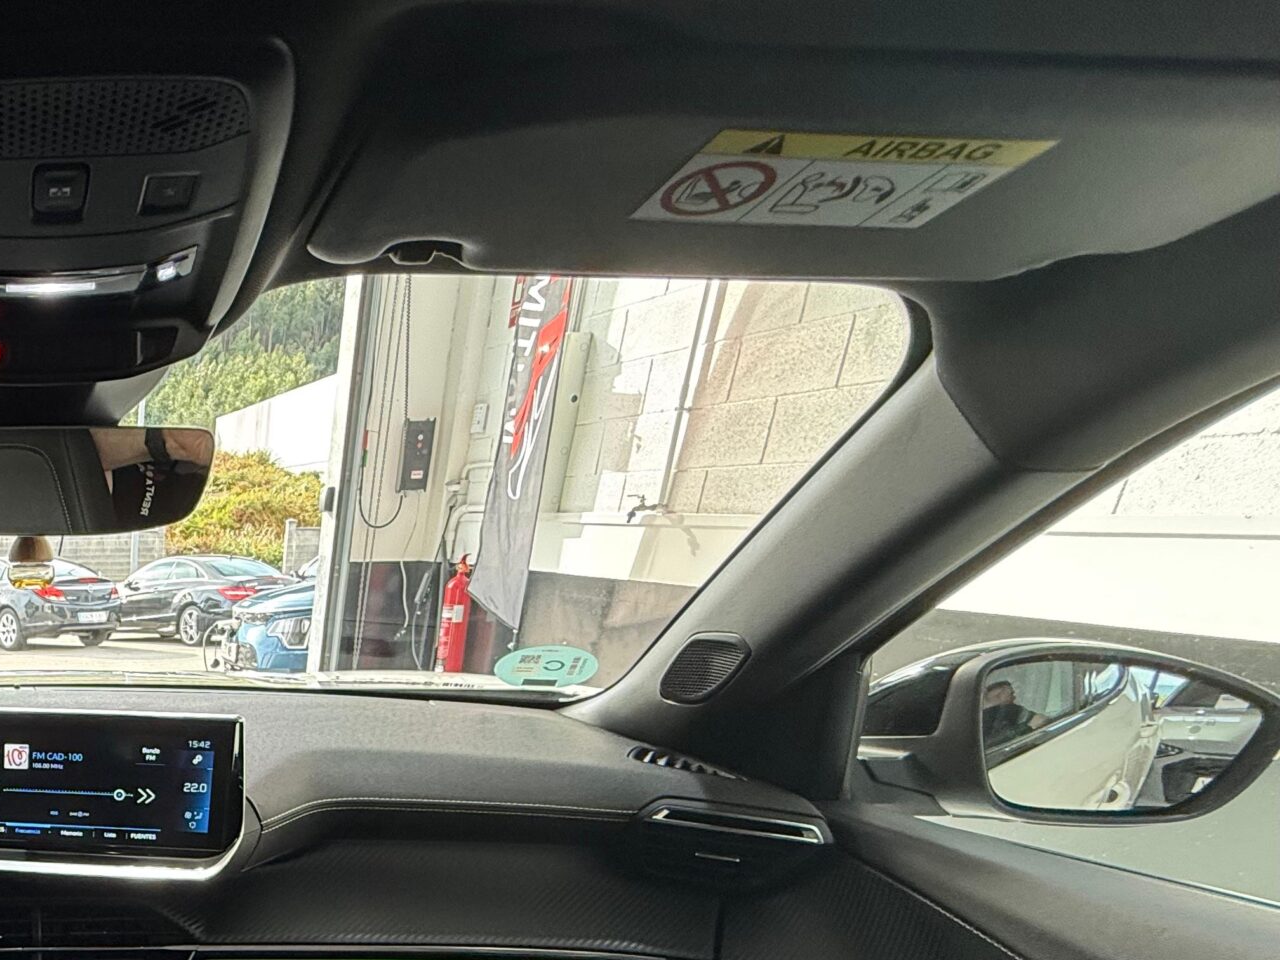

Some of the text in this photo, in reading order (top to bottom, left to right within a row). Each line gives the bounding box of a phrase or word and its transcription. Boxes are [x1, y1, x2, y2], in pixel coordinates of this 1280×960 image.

[843, 138, 1003, 161] AIRBAG
[32, 752, 83, 762] FM CAD-100
[183, 782, 208, 793] 22.0
